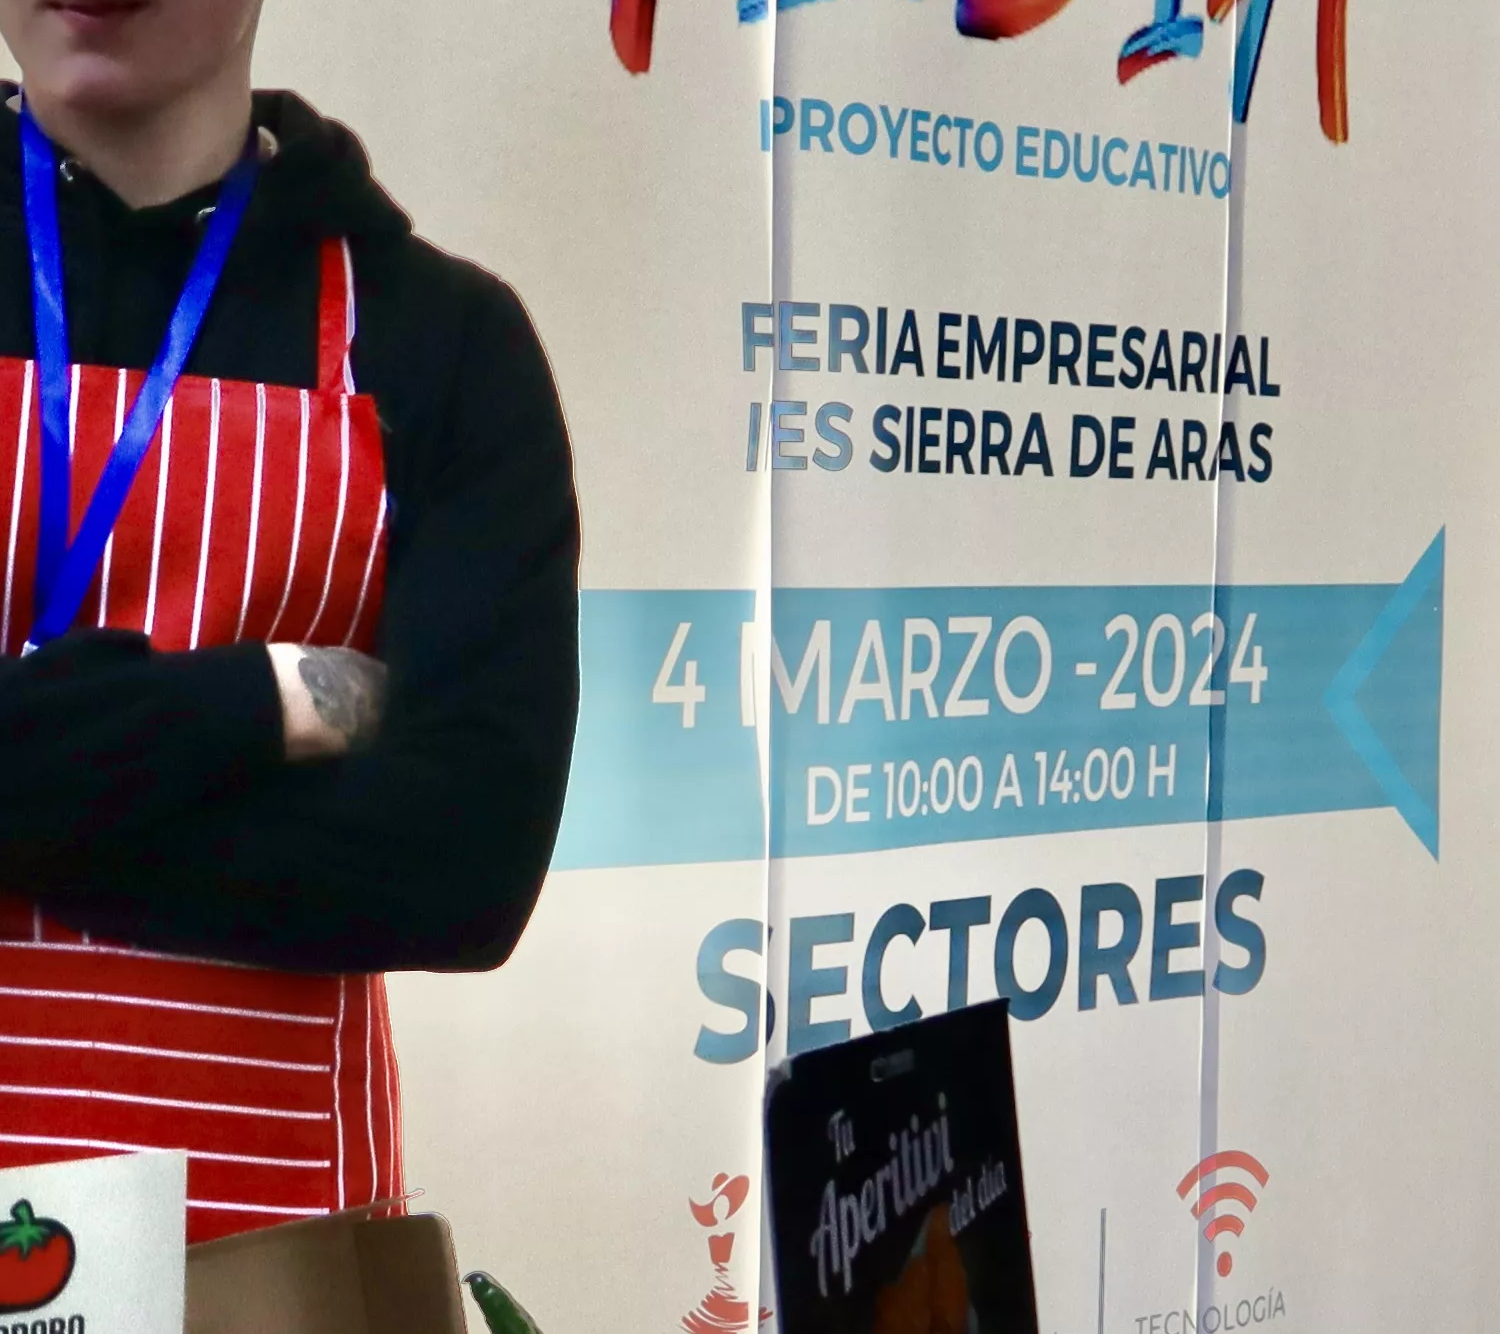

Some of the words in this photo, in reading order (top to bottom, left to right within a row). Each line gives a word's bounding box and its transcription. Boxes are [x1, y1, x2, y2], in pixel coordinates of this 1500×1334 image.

[759, 96, 1003, 173] PROYECTO
[1016, 126, 1232, 199] EDUCATIVO
[741, 300, 924, 377] FERIA
[936, 313, 1282, 399] EMPRESARIAL
[746, 400, 855, 473] IES
[869, 402, 1054, 477] SIERRA
[1069, 415, 1135, 480] DE
[1145, 419, 1274, 484] ARAS
[651, 621, 707, 730] 4
[741, 614, 1053, 729] MARZO
[806, 764, 870, 827] DE
[883, 754, 985, 819] 10:00
[993, 752, 1023, 810] A
[1035, 746, 1138, 806] 14:00
[1148, 743, 1177, 799] H
[693, 868, 1268, 1065] SECTORES
[827, 1109, 856, 1164] Tu
